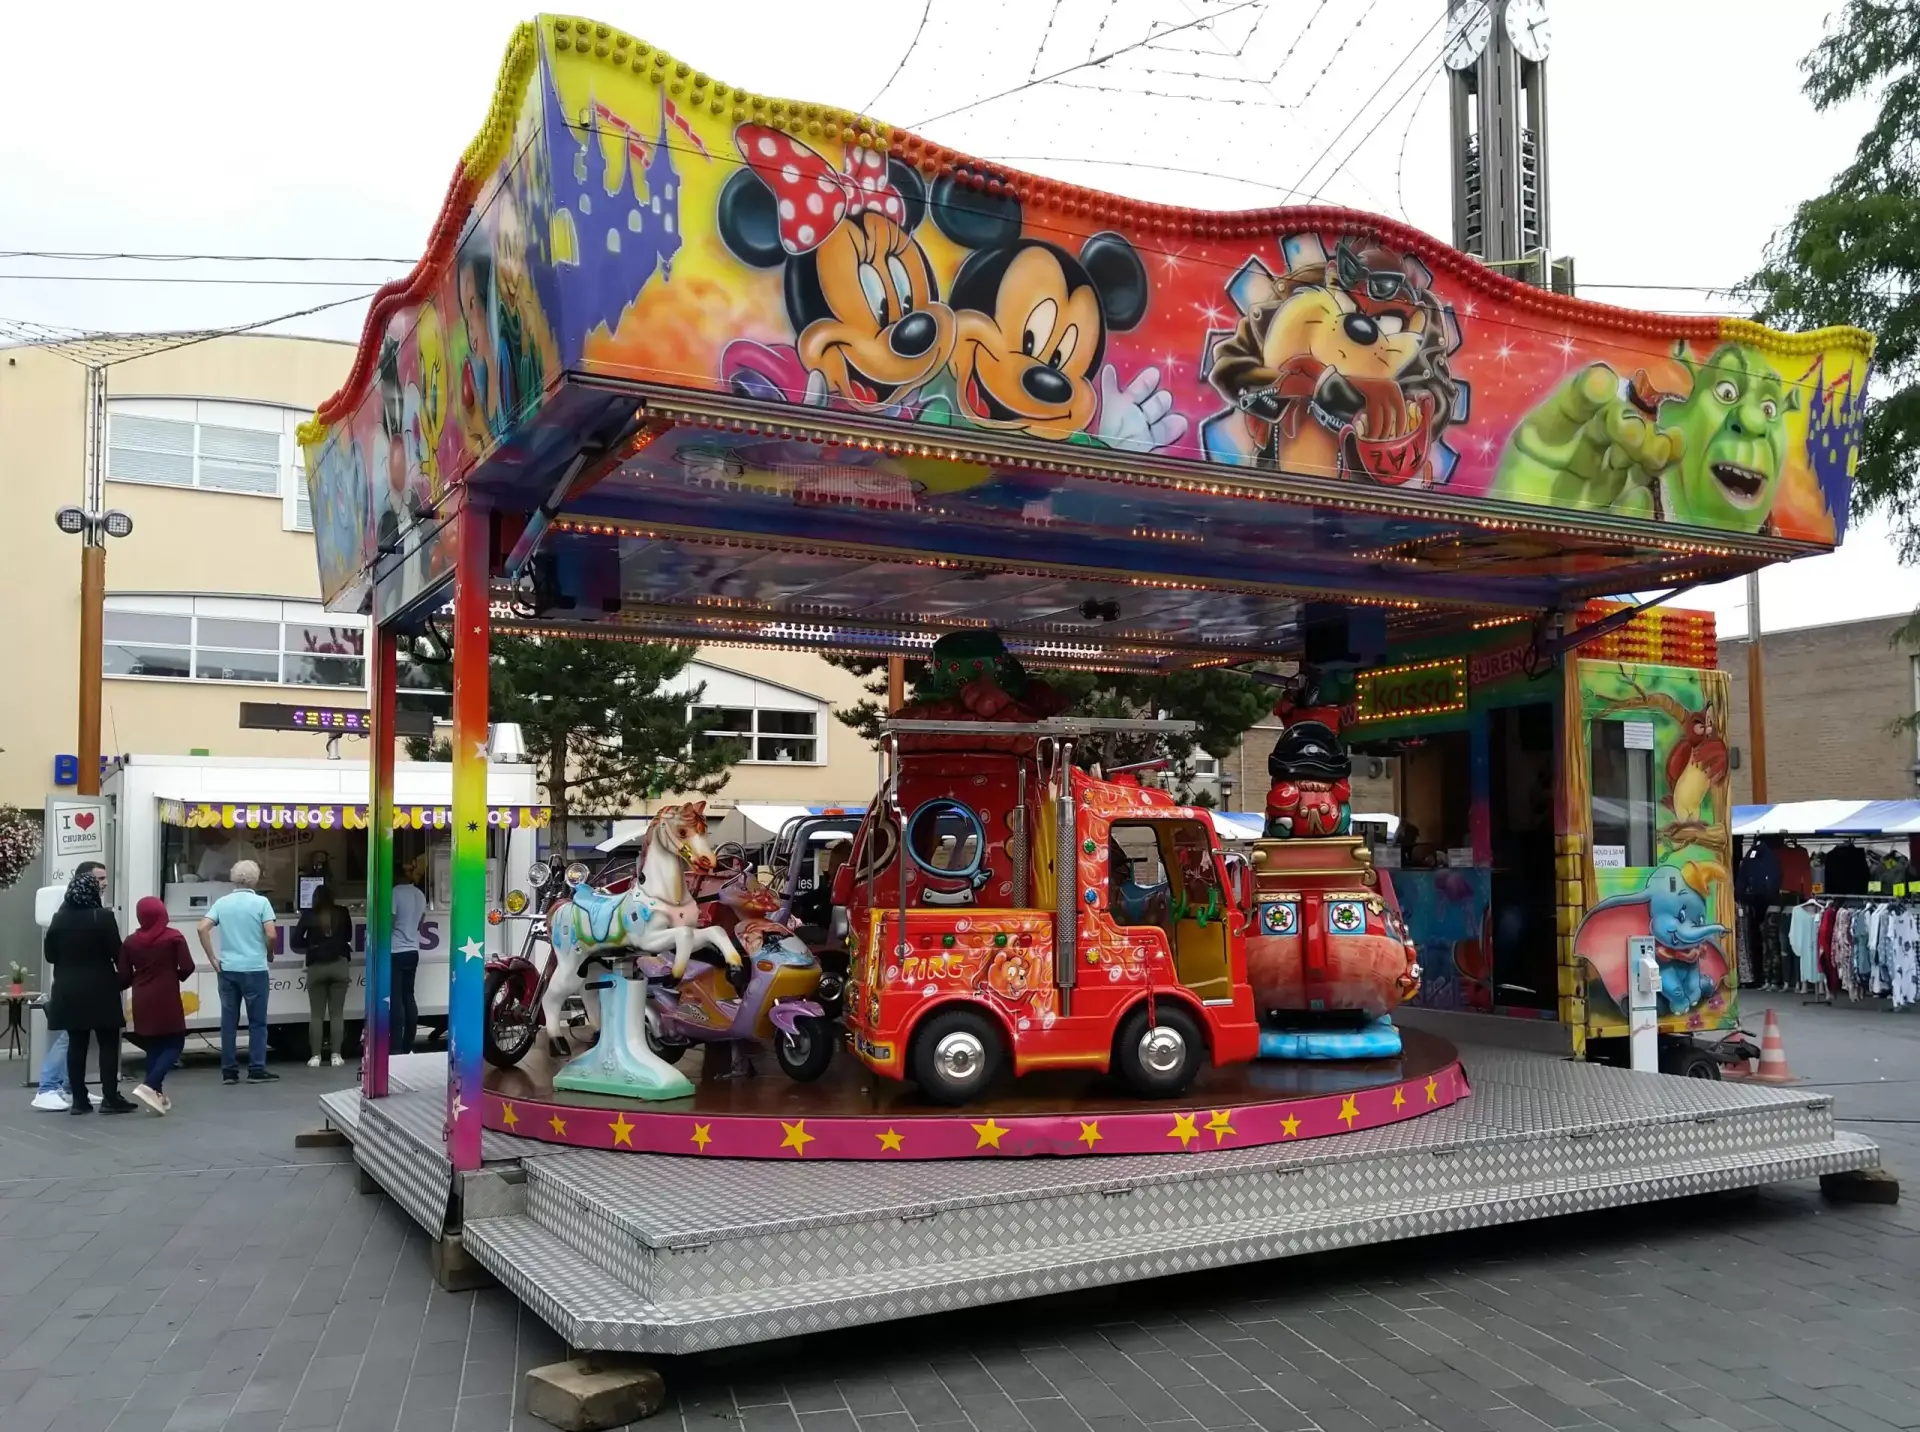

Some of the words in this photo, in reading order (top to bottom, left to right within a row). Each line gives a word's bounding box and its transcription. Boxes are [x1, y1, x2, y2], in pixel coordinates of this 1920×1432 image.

[1372, 676, 1449, 714] kassa
[231, 808, 336, 824] CHURROS
[62, 833, 97, 843] CHURROS
[901, 955, 965, 982] FIRE
